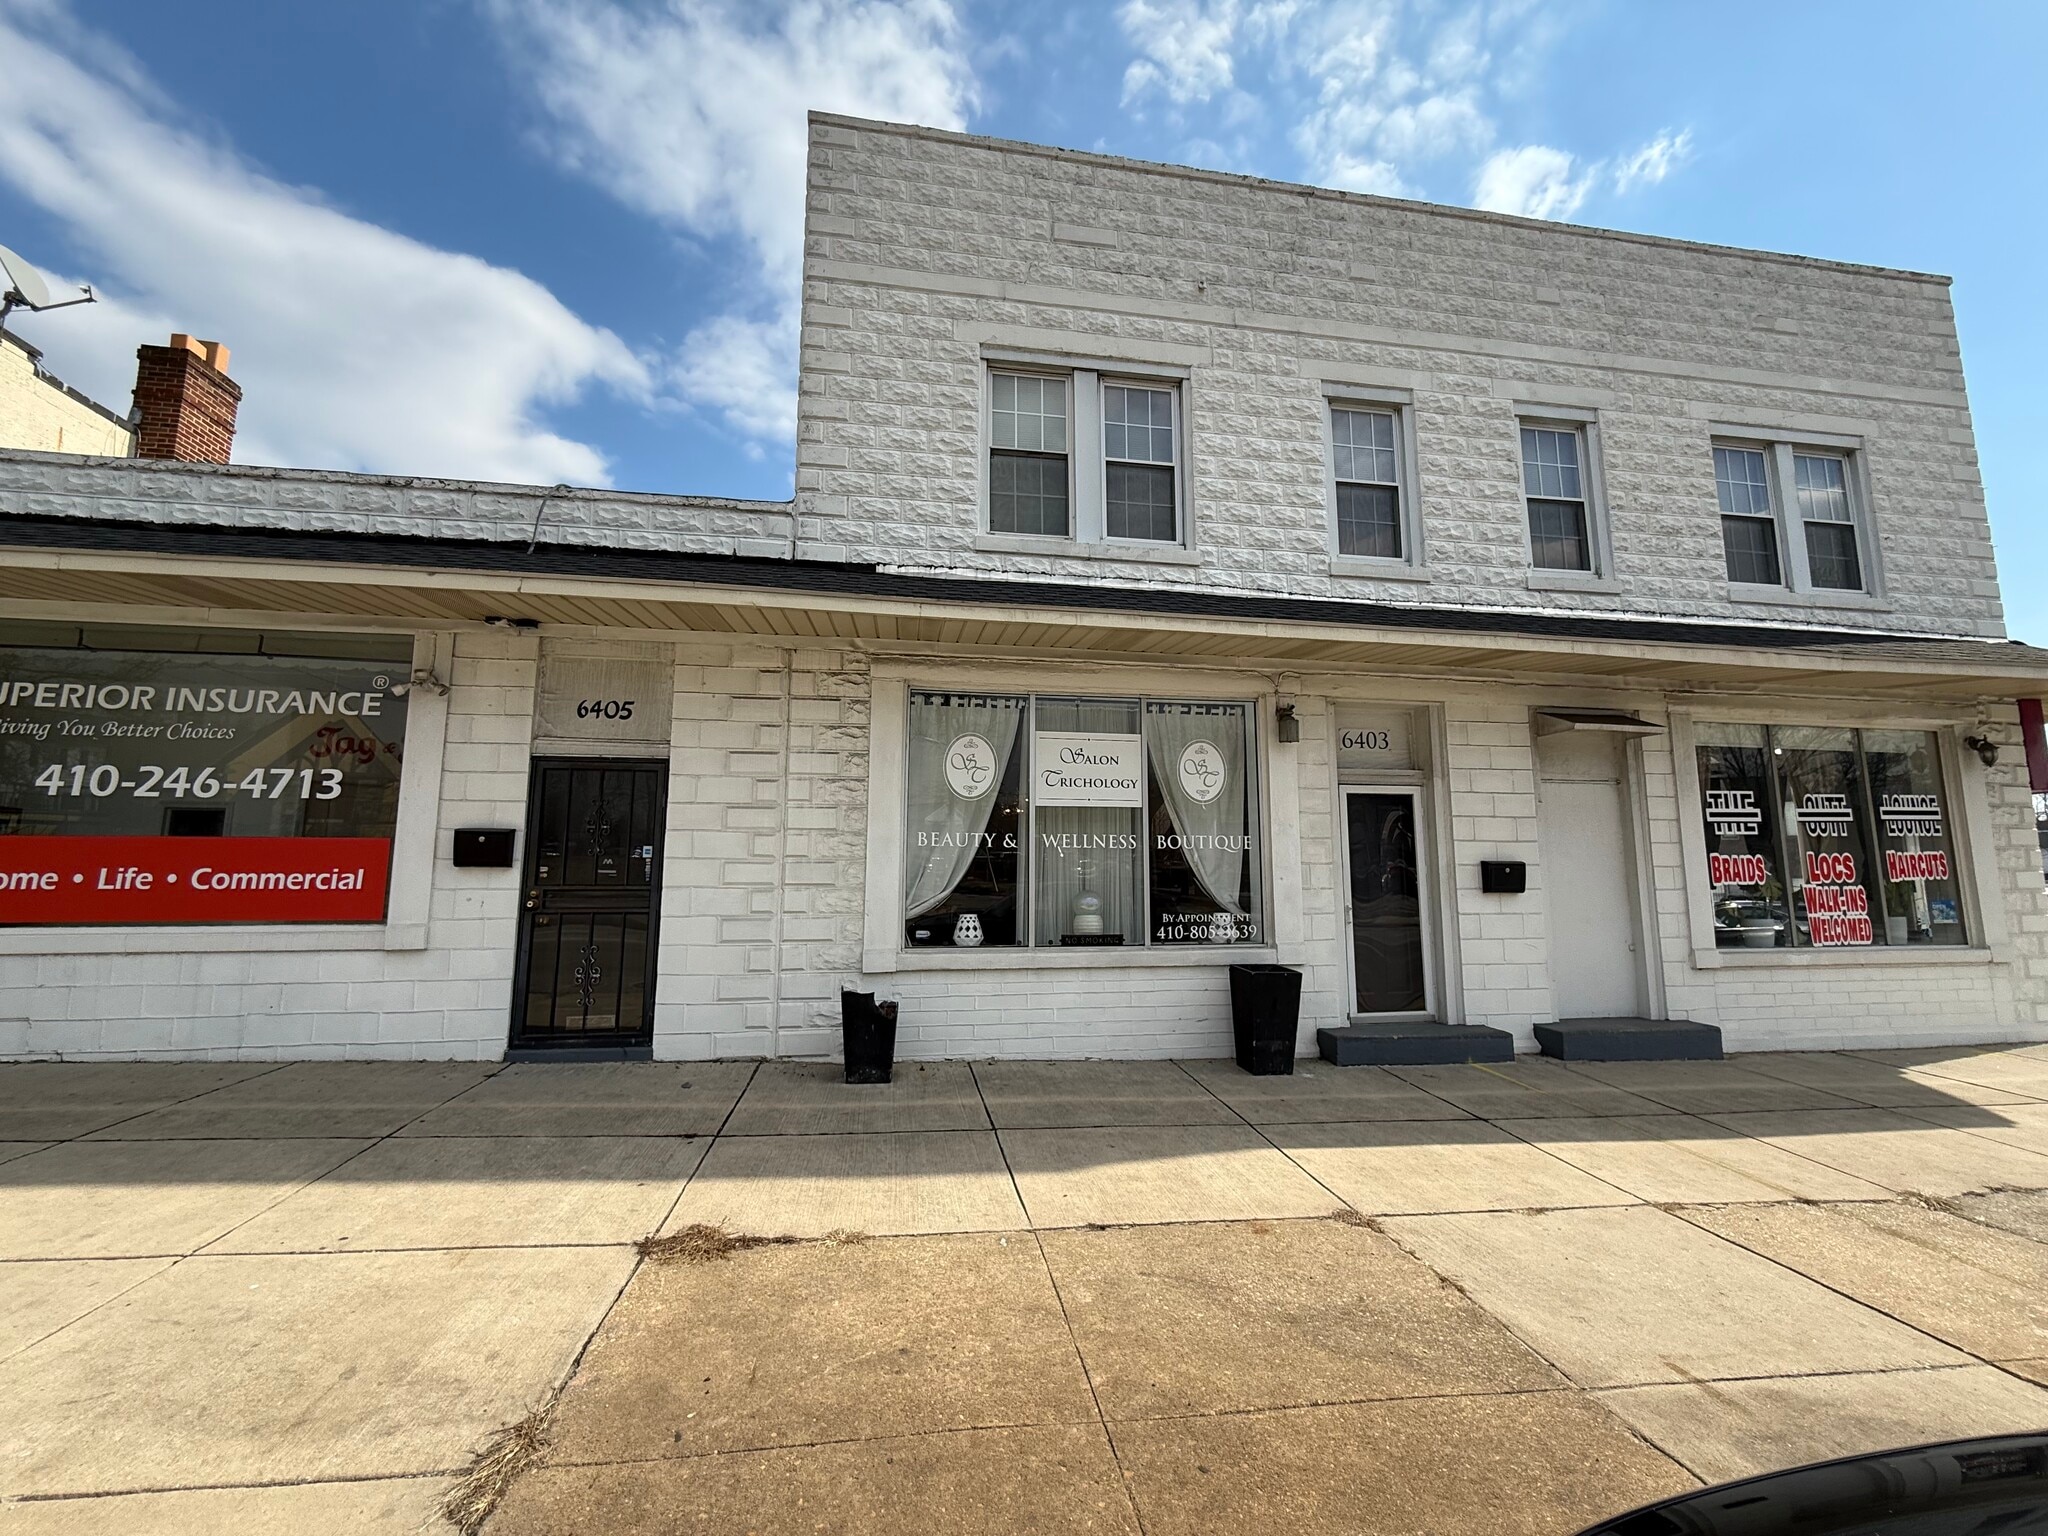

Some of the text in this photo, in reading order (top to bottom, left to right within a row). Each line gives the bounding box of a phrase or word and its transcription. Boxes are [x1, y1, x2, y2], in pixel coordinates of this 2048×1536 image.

[166, 687, 384, 716] INSURANCE
[576, 700, 635, 720] 6405
[0, 718, 236, 741] iving You Better Choices
[1341, 730, 1389, 750] 6403
[1059, 747, 1120, 766] SALON
[35, 764, 344, 800] 410-246-4713
[1041, 769, 1139, 789] TRICHOLOGY
[1706, 790, 1761, 836] THE
[917, 831, 1253, 853] BEAUTY & WELLNESS BOUTIQUE
[97, 867, 154, 890] Life
[191, 867, 365, 890] Commercial
[1709, 850, 1949, 886] BRAIDS LOCS HAIRCUTS
[1802, 884, 1868, 915] WALK-INS
[1162, 913, 1175, 923] BY
[1156, 924, 1257, 939] 410-805-3639
[1808, 914, 1873, 947] WELCOMED
